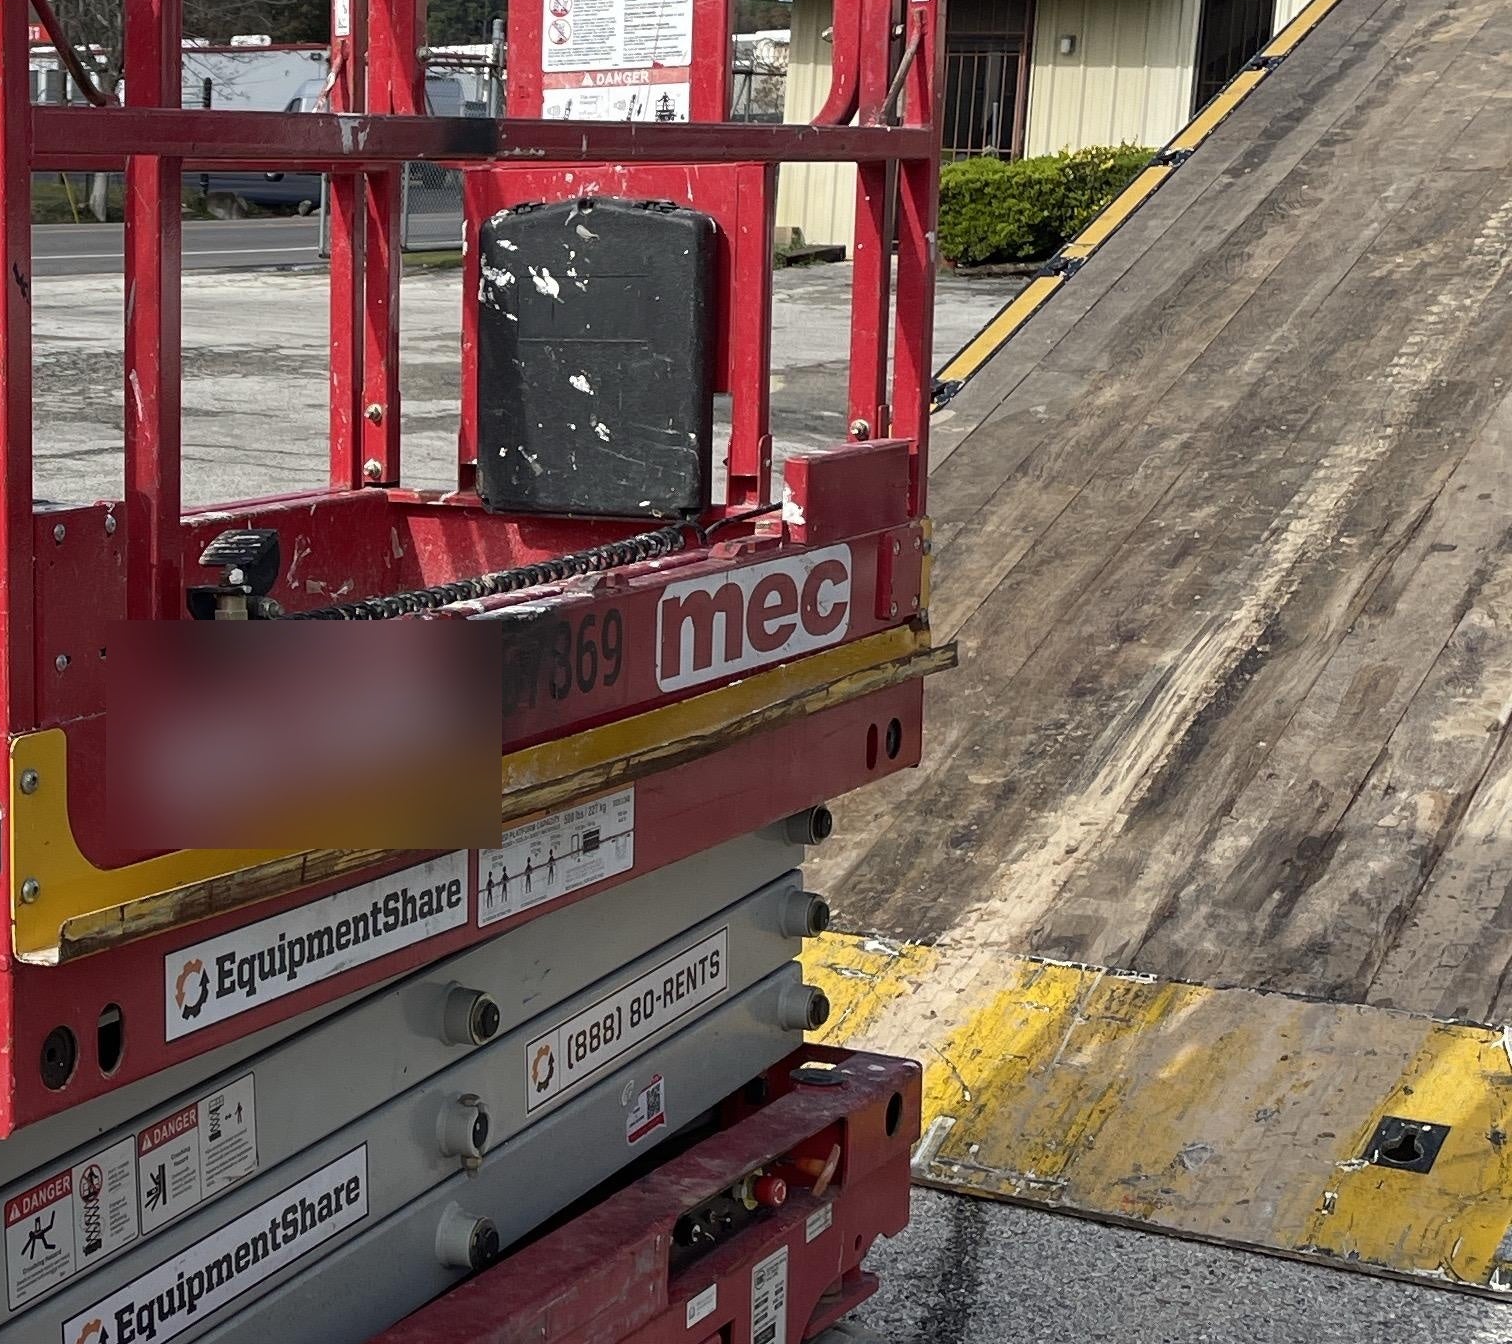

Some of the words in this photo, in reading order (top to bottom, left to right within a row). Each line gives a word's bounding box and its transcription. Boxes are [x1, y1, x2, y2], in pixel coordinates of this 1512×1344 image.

[596, 70, 650, 87] DANGER
[660, 559, 849, 682] mec
[215, 878, 462, 1000] EquipmentShare
[566, 1006, 623, 1070] (888)
[629, 949, 721, 1029] 80-RENTS
[153, 1108, 197, 1145] DANGER
[21, 1177, 71, 1215] DANGER
